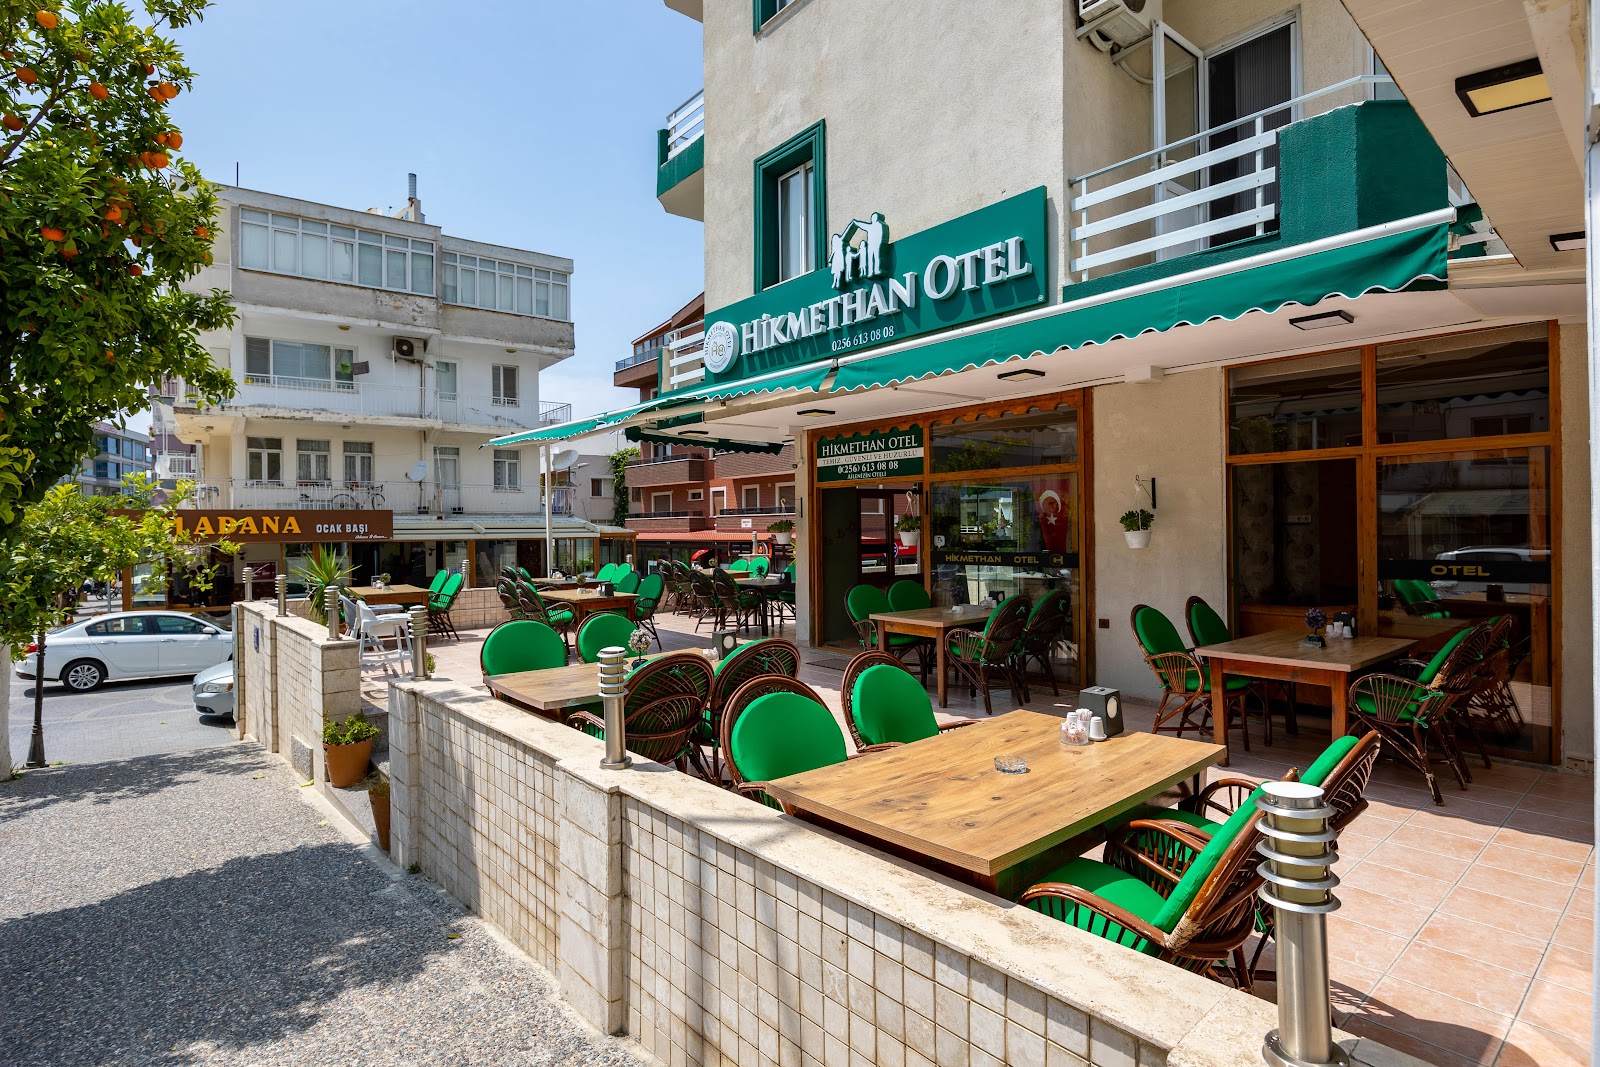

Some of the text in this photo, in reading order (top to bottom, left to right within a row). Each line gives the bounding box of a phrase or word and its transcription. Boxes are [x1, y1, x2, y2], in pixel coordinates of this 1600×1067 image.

[740, 236, 1033, 356] HİKMETHAN OTEL
[831, 325, 894, 351] 0256 613 08 08
[822, 435, 918, 456] HİKMETHAN OTEL
[883, 450, 918, 459] HUZURLU
[837, 460, 899, 474] 0(256) 613 08 08
[193, 516, 302, 535] ADANA
[316, 523, 342, 533] OCAK
[345, 523, 368, 535] BAŞI
[945, 553, 1040, 564] HİKMETHAN OTEL
[1430, 565, 1491, 576] OTEL
